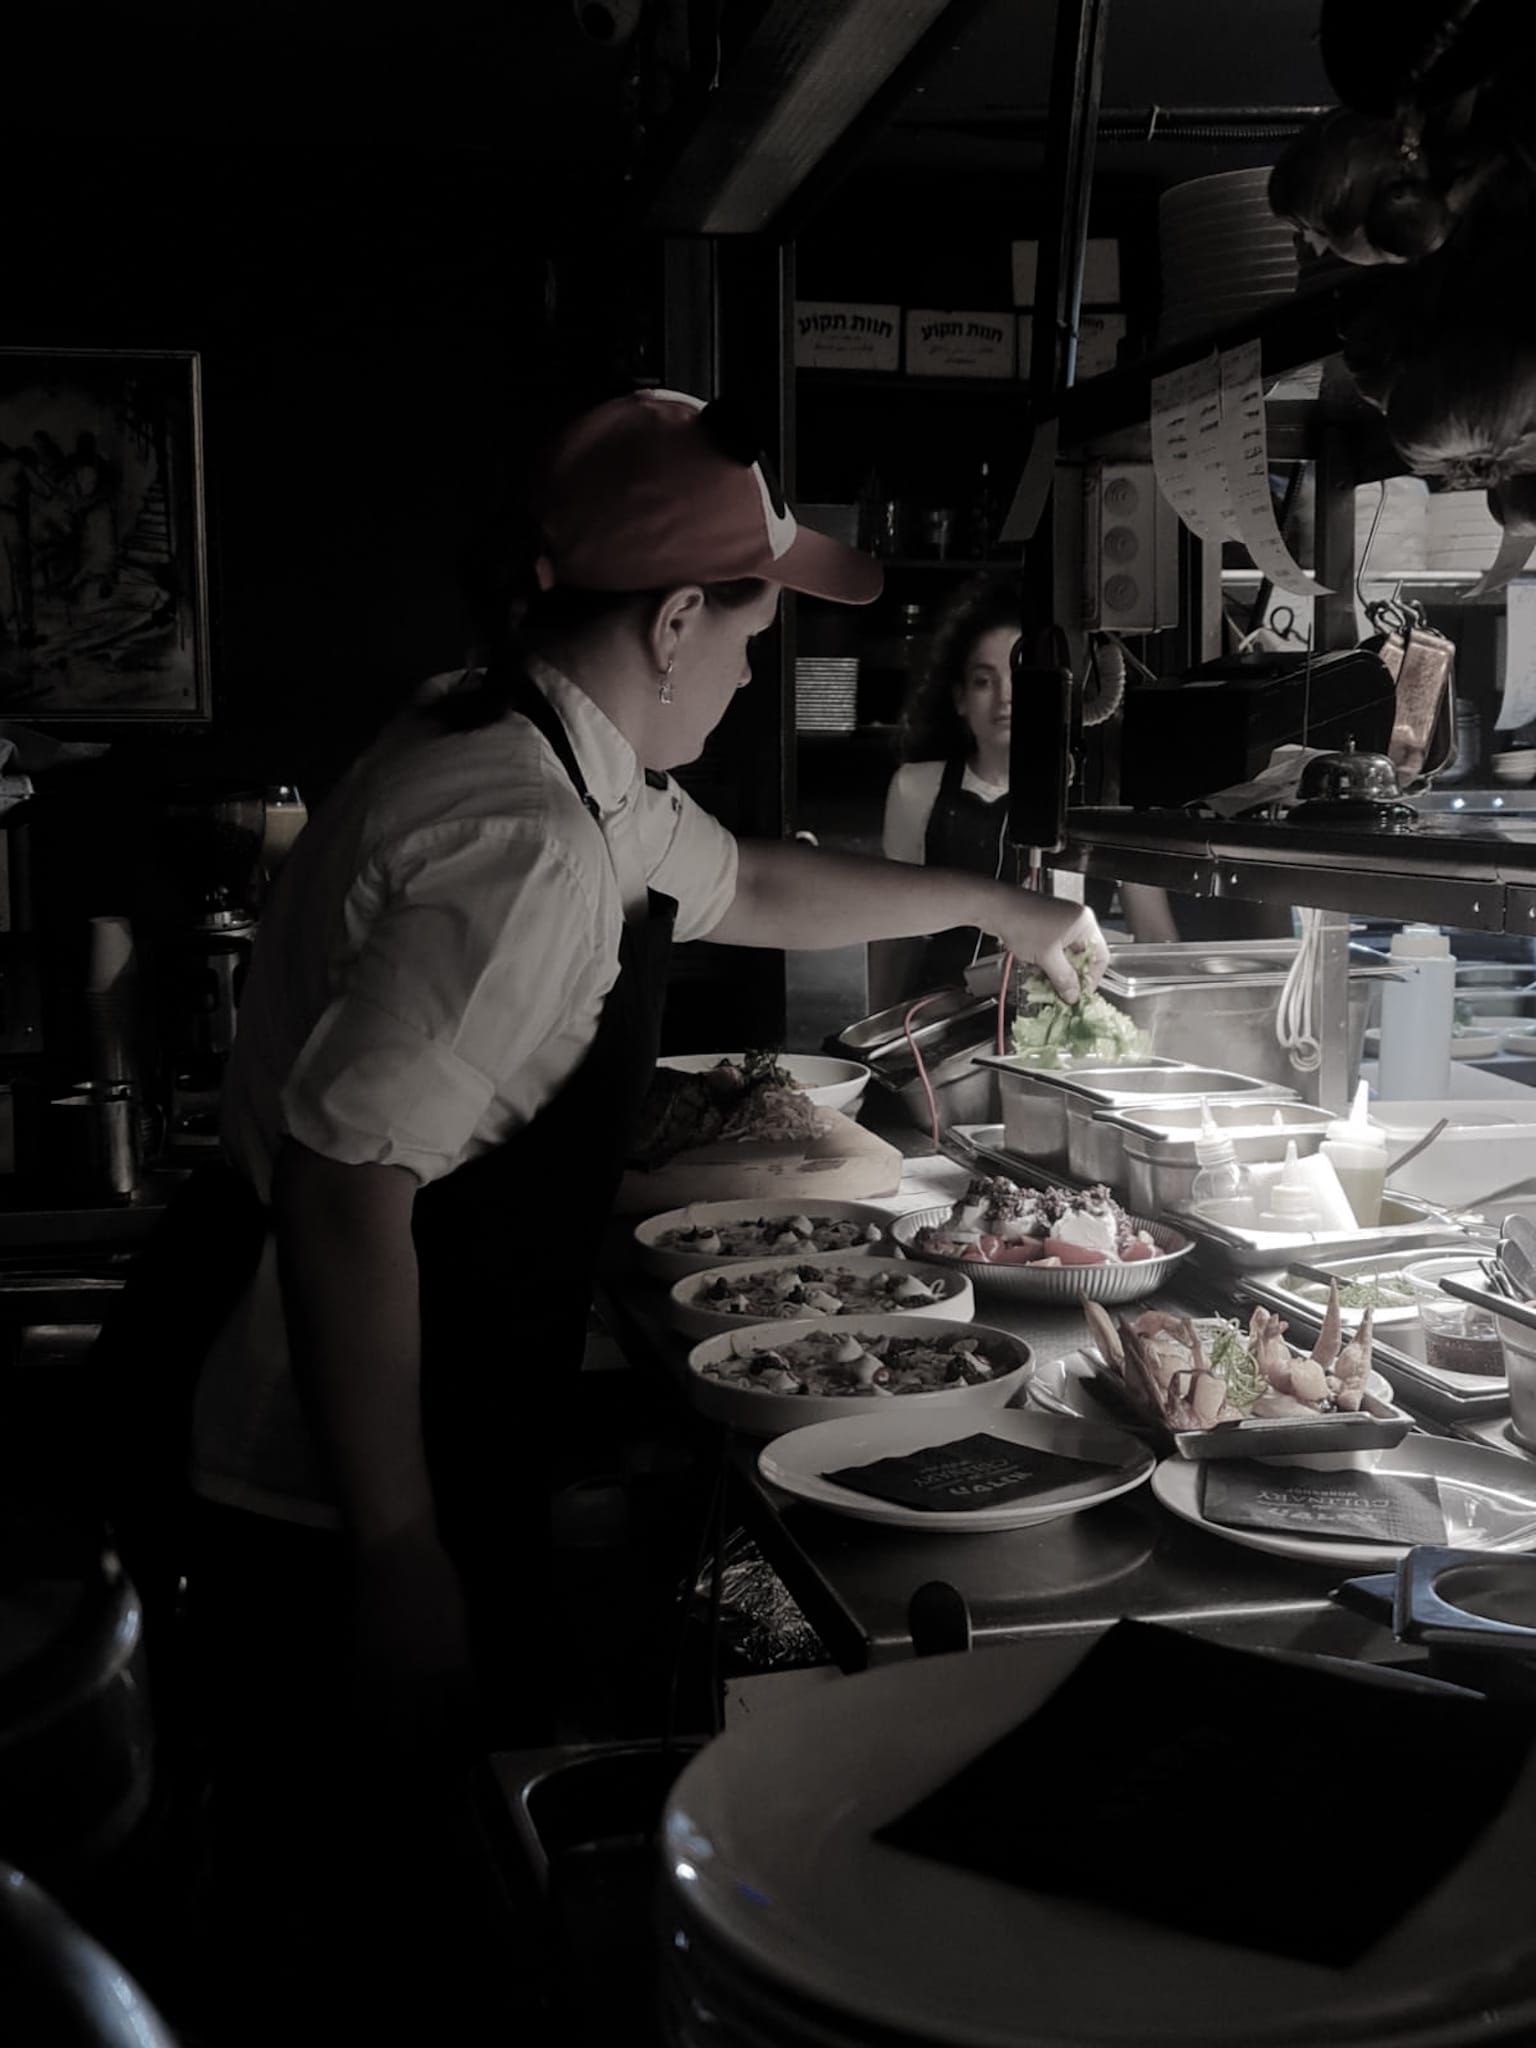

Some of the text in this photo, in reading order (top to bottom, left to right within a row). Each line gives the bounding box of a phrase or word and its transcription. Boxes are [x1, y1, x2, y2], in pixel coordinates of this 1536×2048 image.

[798, 313, 893, 338] חוות תקוע
[921, 321, 1003, 343] חוות תקוע
[1256, 1492, 1390, 1508] CULINARY
